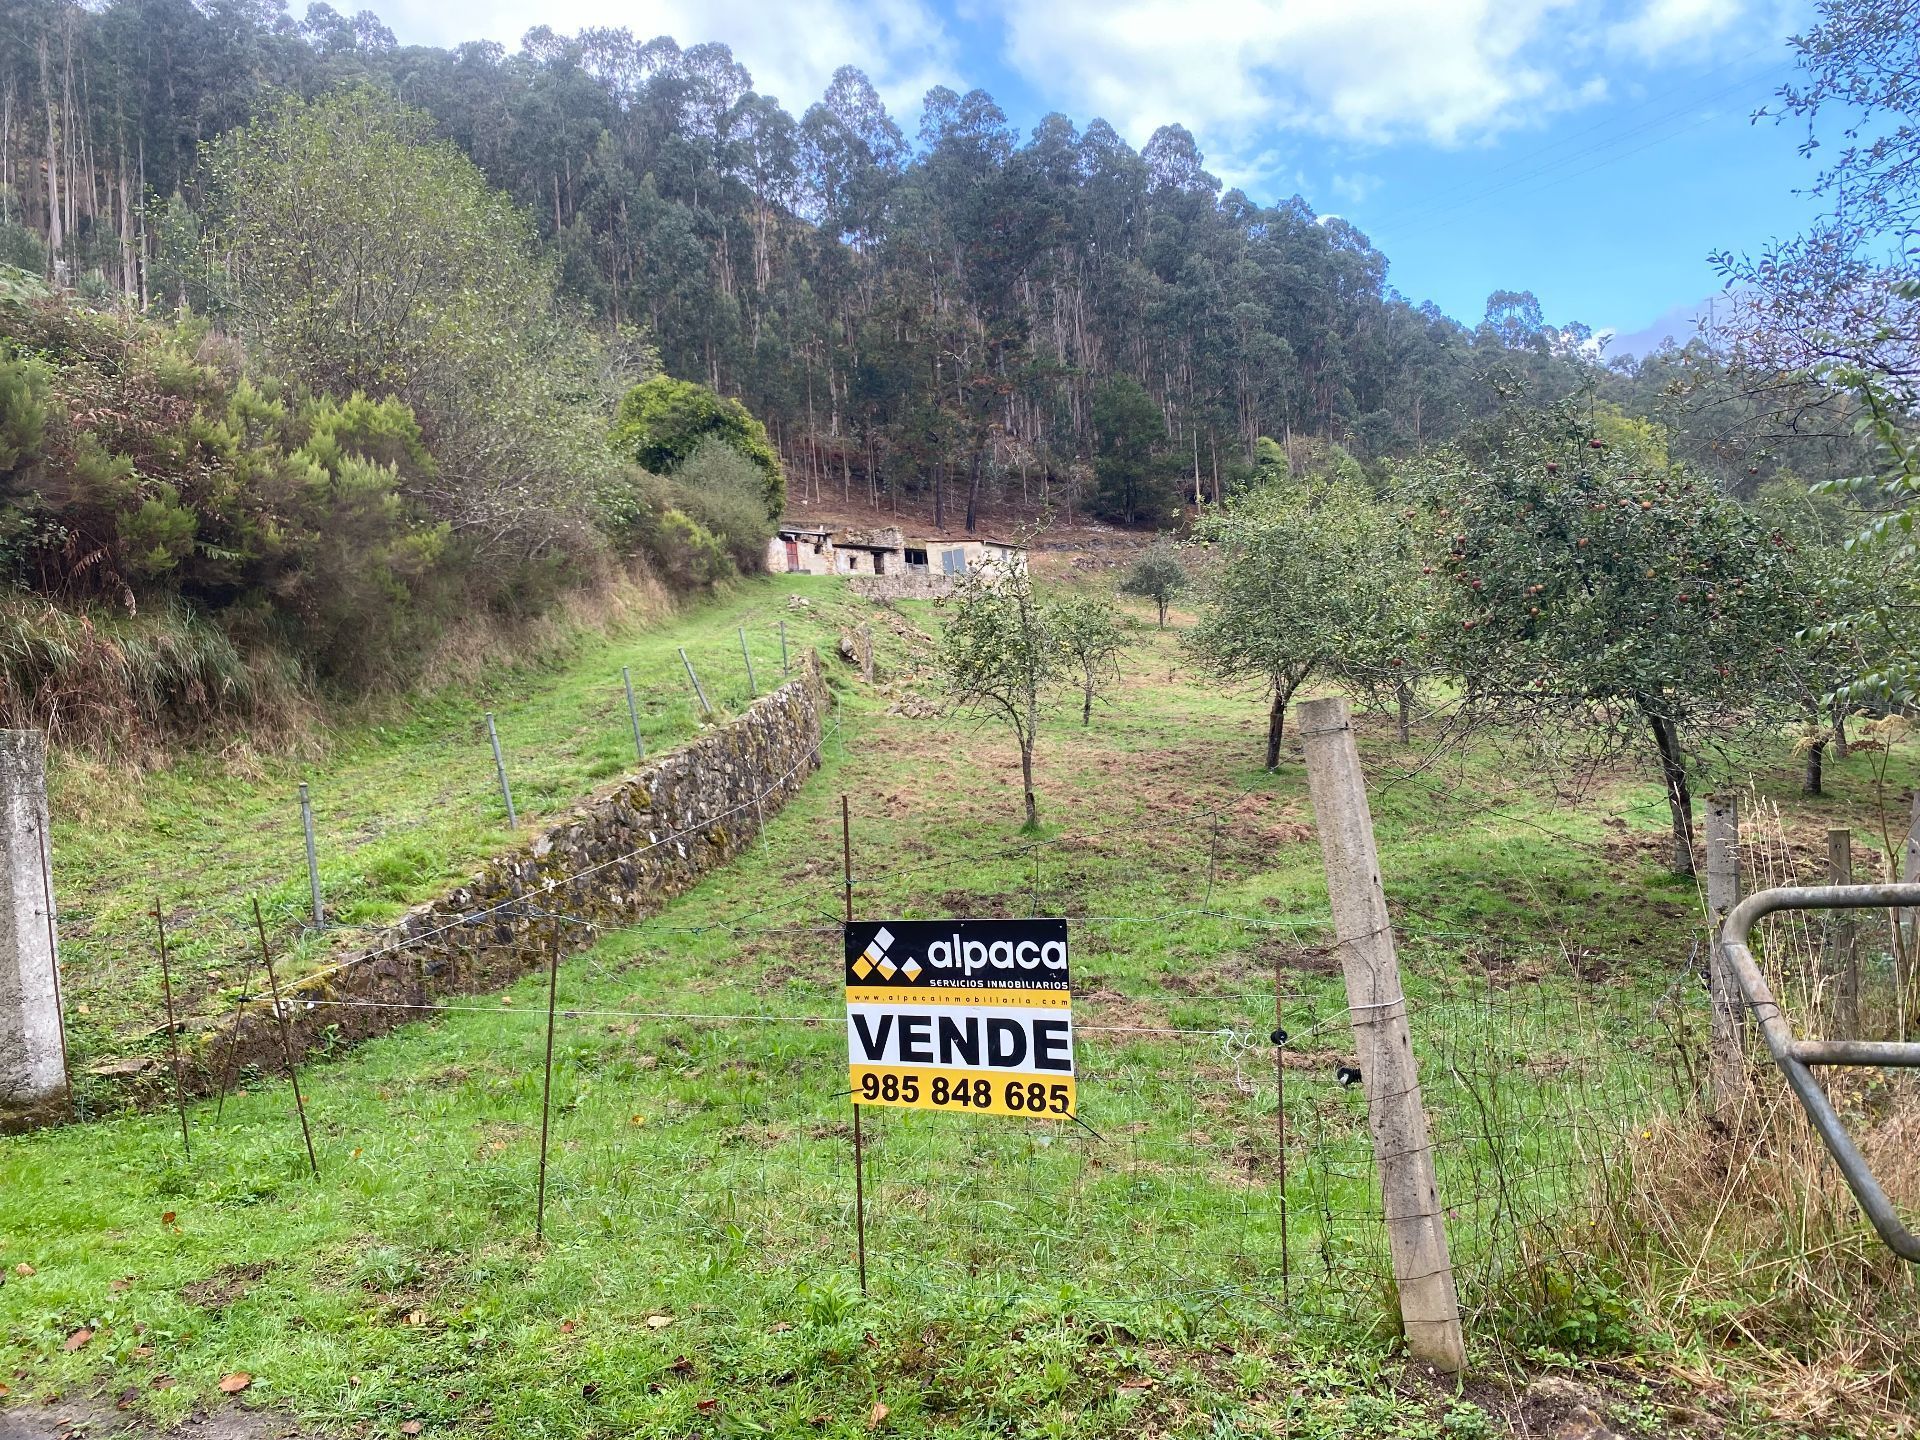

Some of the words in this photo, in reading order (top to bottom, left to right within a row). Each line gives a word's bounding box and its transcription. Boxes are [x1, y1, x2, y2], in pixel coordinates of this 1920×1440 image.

[927, 933, 1068, 976] alpaca
[929, 979, 984, 988] SERVICIOS
[987, 980, 1069, 990] INMOBILIARIOS
[851, 1013, 1072, 1071] VENDE
[861, 1072, 920, 1103] 985
[931, 1077, 992, 1108] 848
[1005, 1081, 1069, 1114] 685
